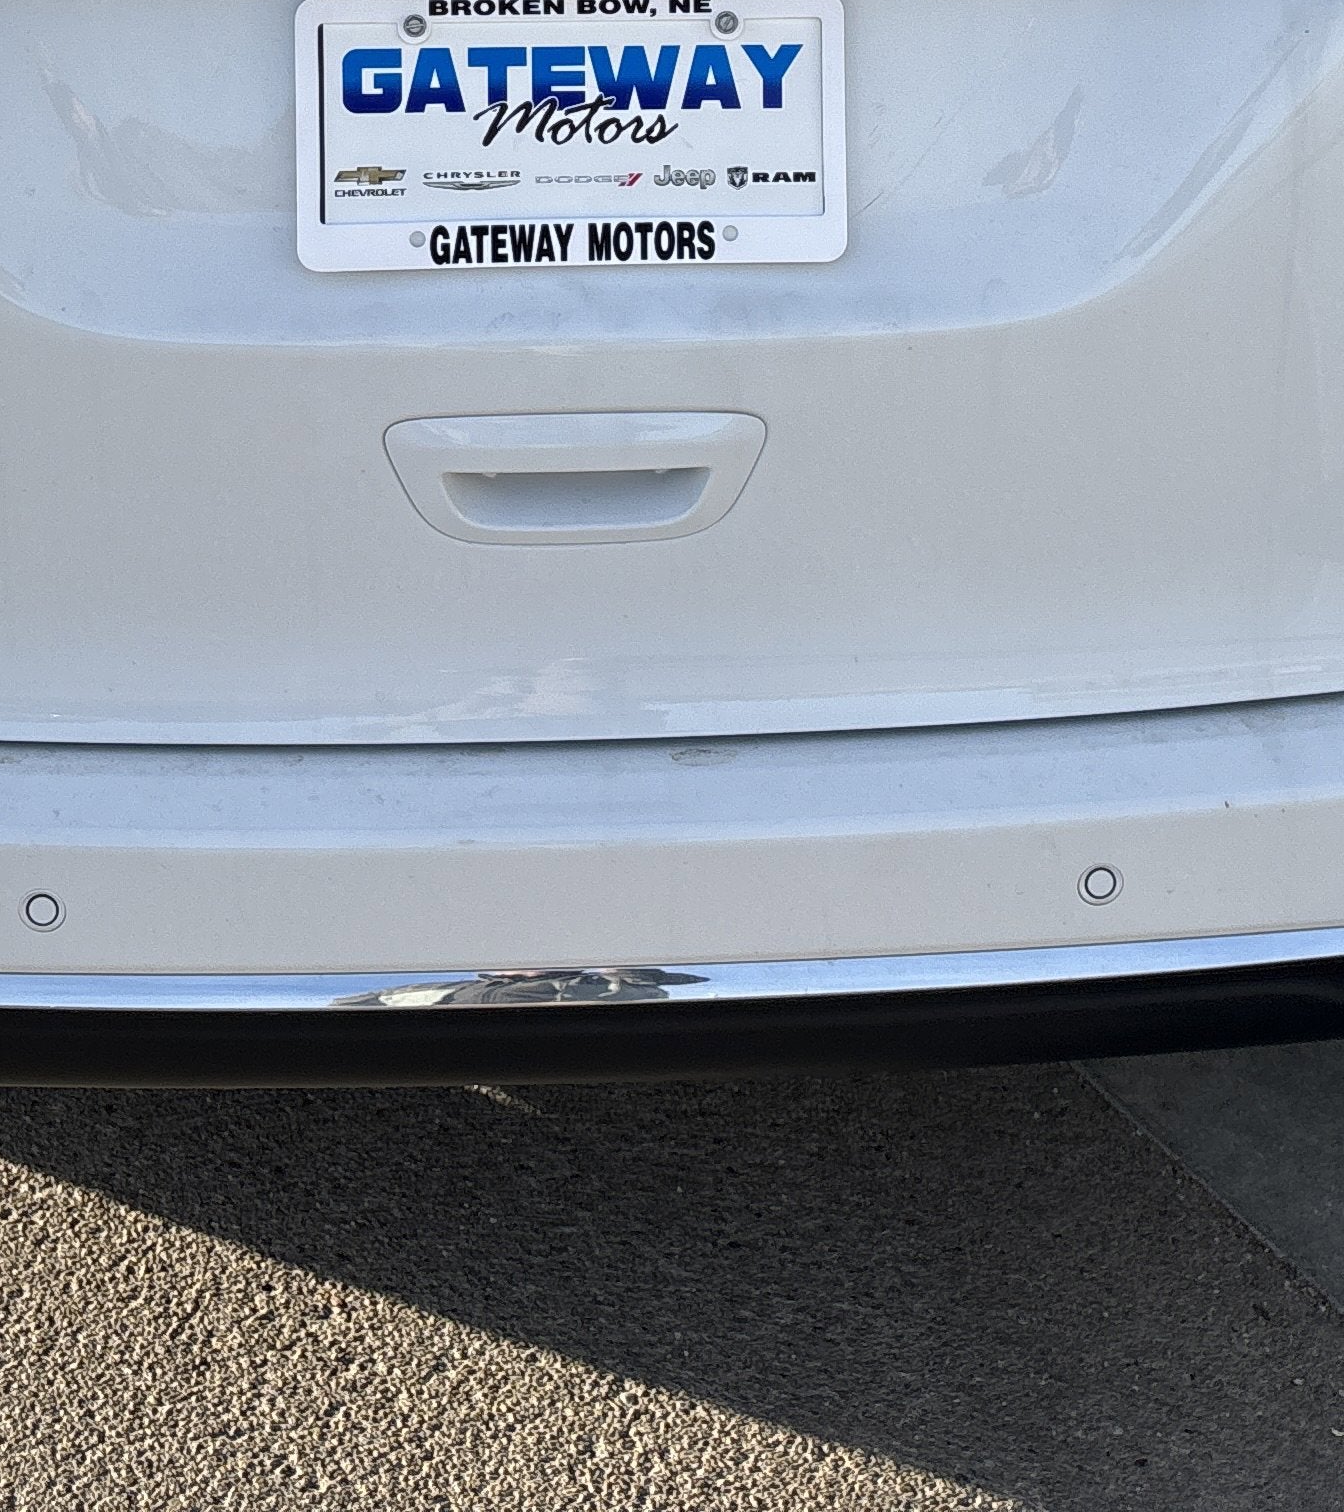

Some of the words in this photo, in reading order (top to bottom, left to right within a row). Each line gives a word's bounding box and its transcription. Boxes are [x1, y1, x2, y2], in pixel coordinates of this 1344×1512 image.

[342, 44, 804, 113] GATEWAY
[473, 94, 679, 147] Motors
[422, 170, 521, 180] CHRYSLER
[534, 174, 629, 185] DODGE
[653, 164, 717, 190] Jeep
[751, 171, 817, 183] RAM
[334, 188, 406, 198] CHEVROLET
[429, 224, 574, 265] GATEWAY
[587, 220, 716, 262] MOTORS
